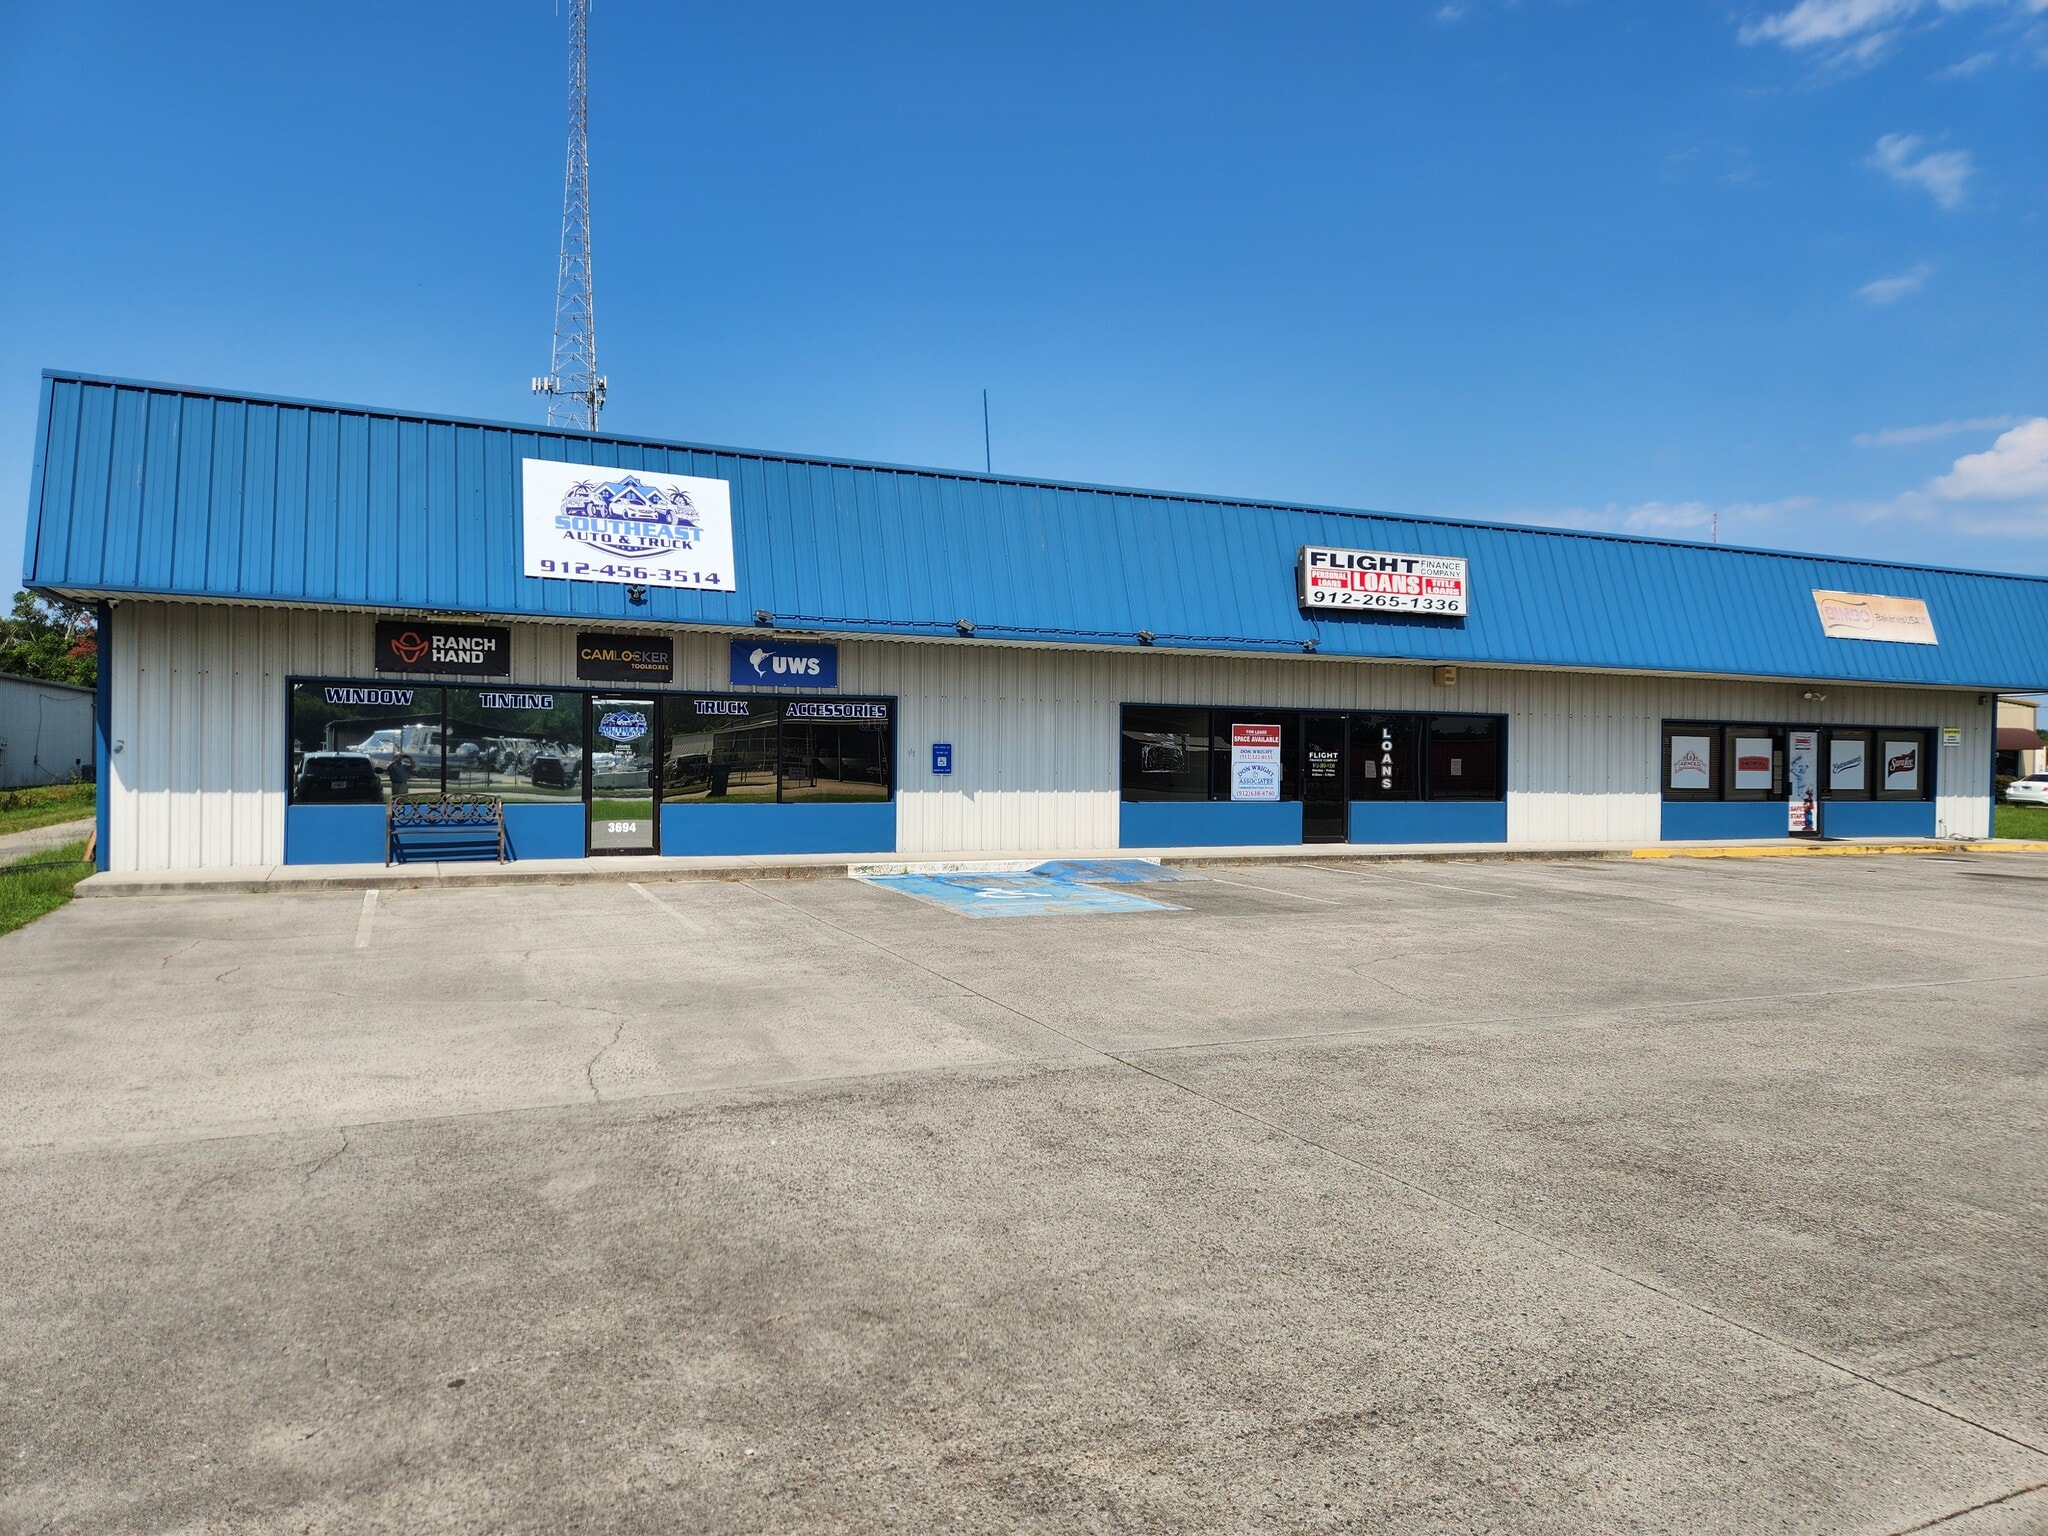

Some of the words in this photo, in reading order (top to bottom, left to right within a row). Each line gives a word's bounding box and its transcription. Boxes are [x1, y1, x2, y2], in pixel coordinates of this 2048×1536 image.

[555, 515, 703, 542] SOUTHEAST
[563, 530, 612, 544] AUTO
[618, 535, 630, 545] &
[639, 536, 693, 550] TRUCK
[1310, 552, 1419, 573] FLIGHT
[1421, 560, 1461, 570] FINANCE
[540, 559, 720, 585] 912-456-3514
[1312, 570, 1348, 580] PERSONAL
[1420, 568, 1461, 577] COMPANY
[1318, 579, 1342, 588] LOANS
[1353, 572, 1420, 595] LOANS
[1427, 586, 1460, 596] LOANS
[1430, 579, 1456, 588] TITLE
[1313, 591, 1459, 612] 912-265-1336
[432, 635, 496, 651] RANCH
[432, 649, 484, 663] HAND
[581, 648, 668, 663] CAMLOCKER
[631, 663, 669, 671] TOOLBOXES
[772, 655, 820, 676] UWS
[325, 687, 413, 705] WINDOW
[479, 692, 553, 709] TINTING
[694, 700, 750, 716] TRUCK
[786, 702, 887, 718] ACCESSORIES
[1380, 727, 1393, 790] LOANS
[1889, 758, 1904, 771] Sara
[1903, 757, 1915, 768] Lee
[1237, 765, 1251, 777] DON
[1251, 765, 1274, 777] WRIGHT
[608, 822, 636, 833] 3694
